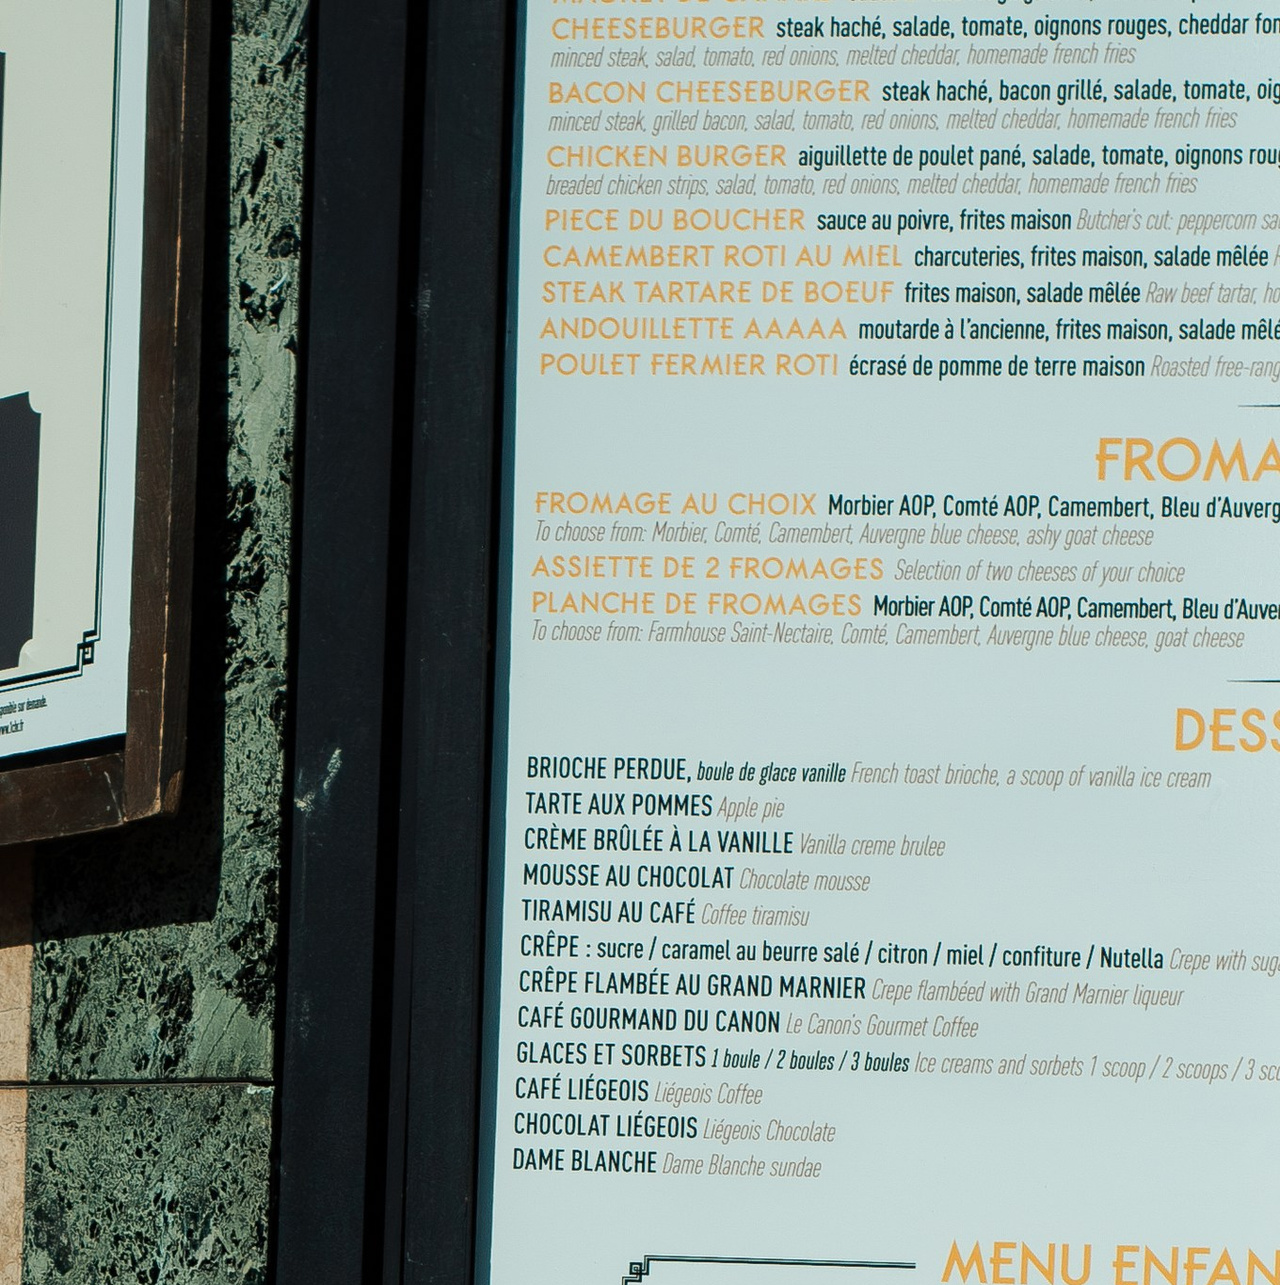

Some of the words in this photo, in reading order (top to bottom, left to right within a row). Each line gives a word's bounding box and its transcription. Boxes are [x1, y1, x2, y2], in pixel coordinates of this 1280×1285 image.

[551, 16, 764, 41] CHEESEBURGER
[777, 16, 824, 38] steak
[830, 15, 886, 39] haché,
[893, 15, 954, 39] salade,
[962, 16, 1027, 38] tomate,
[1034, 14, 1101, 41] oignons
[1108, 19, 1172, 43] rouges,
[1179, 13, 1249, 35] cheddar
[548, 81, 646, 105] BACON
[655, 80, 870, 104] CHEESEBURGER
[547, 145, 667, 169] CHICKEN
[677, 144, 786, 168] BURGER
[545, 209, 619, 232] PIECE
[629, 209, 663, 232] DU
[673, 208, 805, 232] BOUCHER
[542, 245, 715, 269] CAMEMBERT
[724, 245, 786, 268] ROTI
[795, 245, 831, 267] AU
[842, 244, 902, 268] MIEL
[542, 281, 625, 304] STEAK
[633, 281, 751, 304] TARTARE
[762, 281, 794, 304] DE
[804, 280, 894, 304] BOEUF
[539, 317, 734, 340] ANDOUILLETTE
[743, 318, 847, 340] AAAAA
[540, 353, 641, 376] POULET
[650, 353, 765, 376] FERMIER
[776, 353, 837, 376] ROTI
[534, 491, 672, 515] FROMAGE
[681, 493, 717, 515] AU
[728, 493, 816, 516] CHOIX
[531, 555, 653, 578] ASSIETTE
[663, 556, 695, 579] DE
[706, 557, 720, 579] 2
[729, 557, 883, 581] FROMAGES
[894, 558, 961, 581] Selection
[966, 559, 984, 581] of
[986, 561, 1013, 581] two
[1018, 560, 1078, 582] cheeses
[1082, 560, 1100, 582] of
[1098, 566, 1134, 587] your
[1138, 561, 1185, 583] choice
[527, 756, 607, 779] BRIOCHE
[614, 757, 691, 783] PERDUE,
[526, 792, 582, 814] TARTE
[588, 793, 625, 815] AUX
[632, 794, 712, 816] POMMES
[717, 796, 758, 822] Apple
[761, 797, 785, 823] pie
[525, 823, 587, 850] CRÈME
[594, 824, 663, 851] BRÛLÉE
[669, 824, 681, 852] À
[689, 830, 711, 852] LA
[717, 831, 793, 853] VANILLE
[524, 863, 600, 886] MOUSSE
[605, 865, 630, 887] AU
[638, 865, 734, 888] CHOCOLAT
[740, 867, 809, 890] Chocolate
[814, 875, 870, 891] mousse
[522, 899, 611, 922] TIRAMISU
[618, 901, 642, 923] AU
[650, 898, 695, 924] CAFÉ
[518, 1002, 564, 1028] CAFÉ
[571, 1007, 677, 1030] GOURMAND
[684, 1009, 708, 1031] DU
[716, 1010, 780, 1033] CANON
[516, 1073, 561, 1099] CAFÉ
[568, 1074, 648, 1101] LIÉGEOIS
[514, 1112, 610, 1136] CHOCOLAT
[617, 1110, 697, 1138] LIÉGEOIS
[703, 1118, 761, 1145] Liégeois
[766, 1119, 836, 1142] Chocolate
[513, 1148, 565, 1171] DAME
[572, 1150, 657, 1173] BLANCHE
